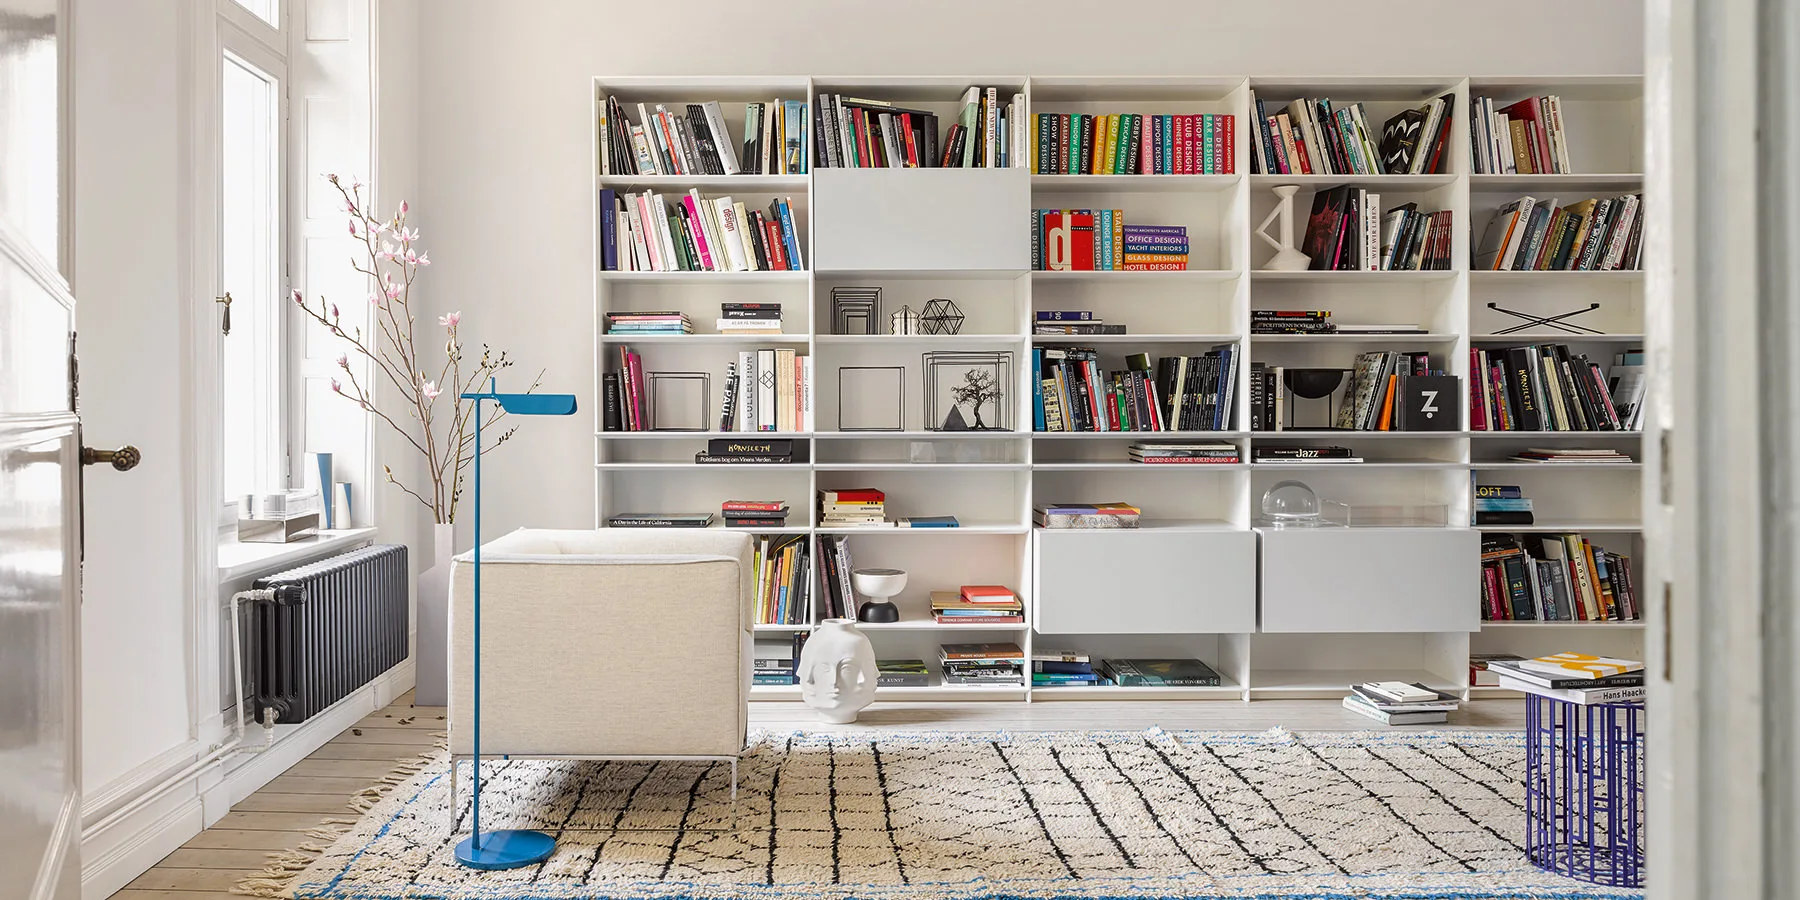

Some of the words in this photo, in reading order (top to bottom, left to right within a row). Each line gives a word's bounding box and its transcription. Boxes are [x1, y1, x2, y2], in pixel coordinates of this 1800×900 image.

[1132, 117, 1141, 140] LOBBY
[726, 208, 735, 232] design
[1521, 199, 1532, 223] FURNISH
[772, 225, 782, 263] Minimalismus
[1530, 230, 1541, 249] GLASS
[726, 361, 736, 385] THE
[1518, 369, 1533, 411] HORNSLETH
[721, 390, 731, 418] PAUL
[1296, 449, 1319, 458] Jazz
[1603, 691, 1621, 700] Hans
